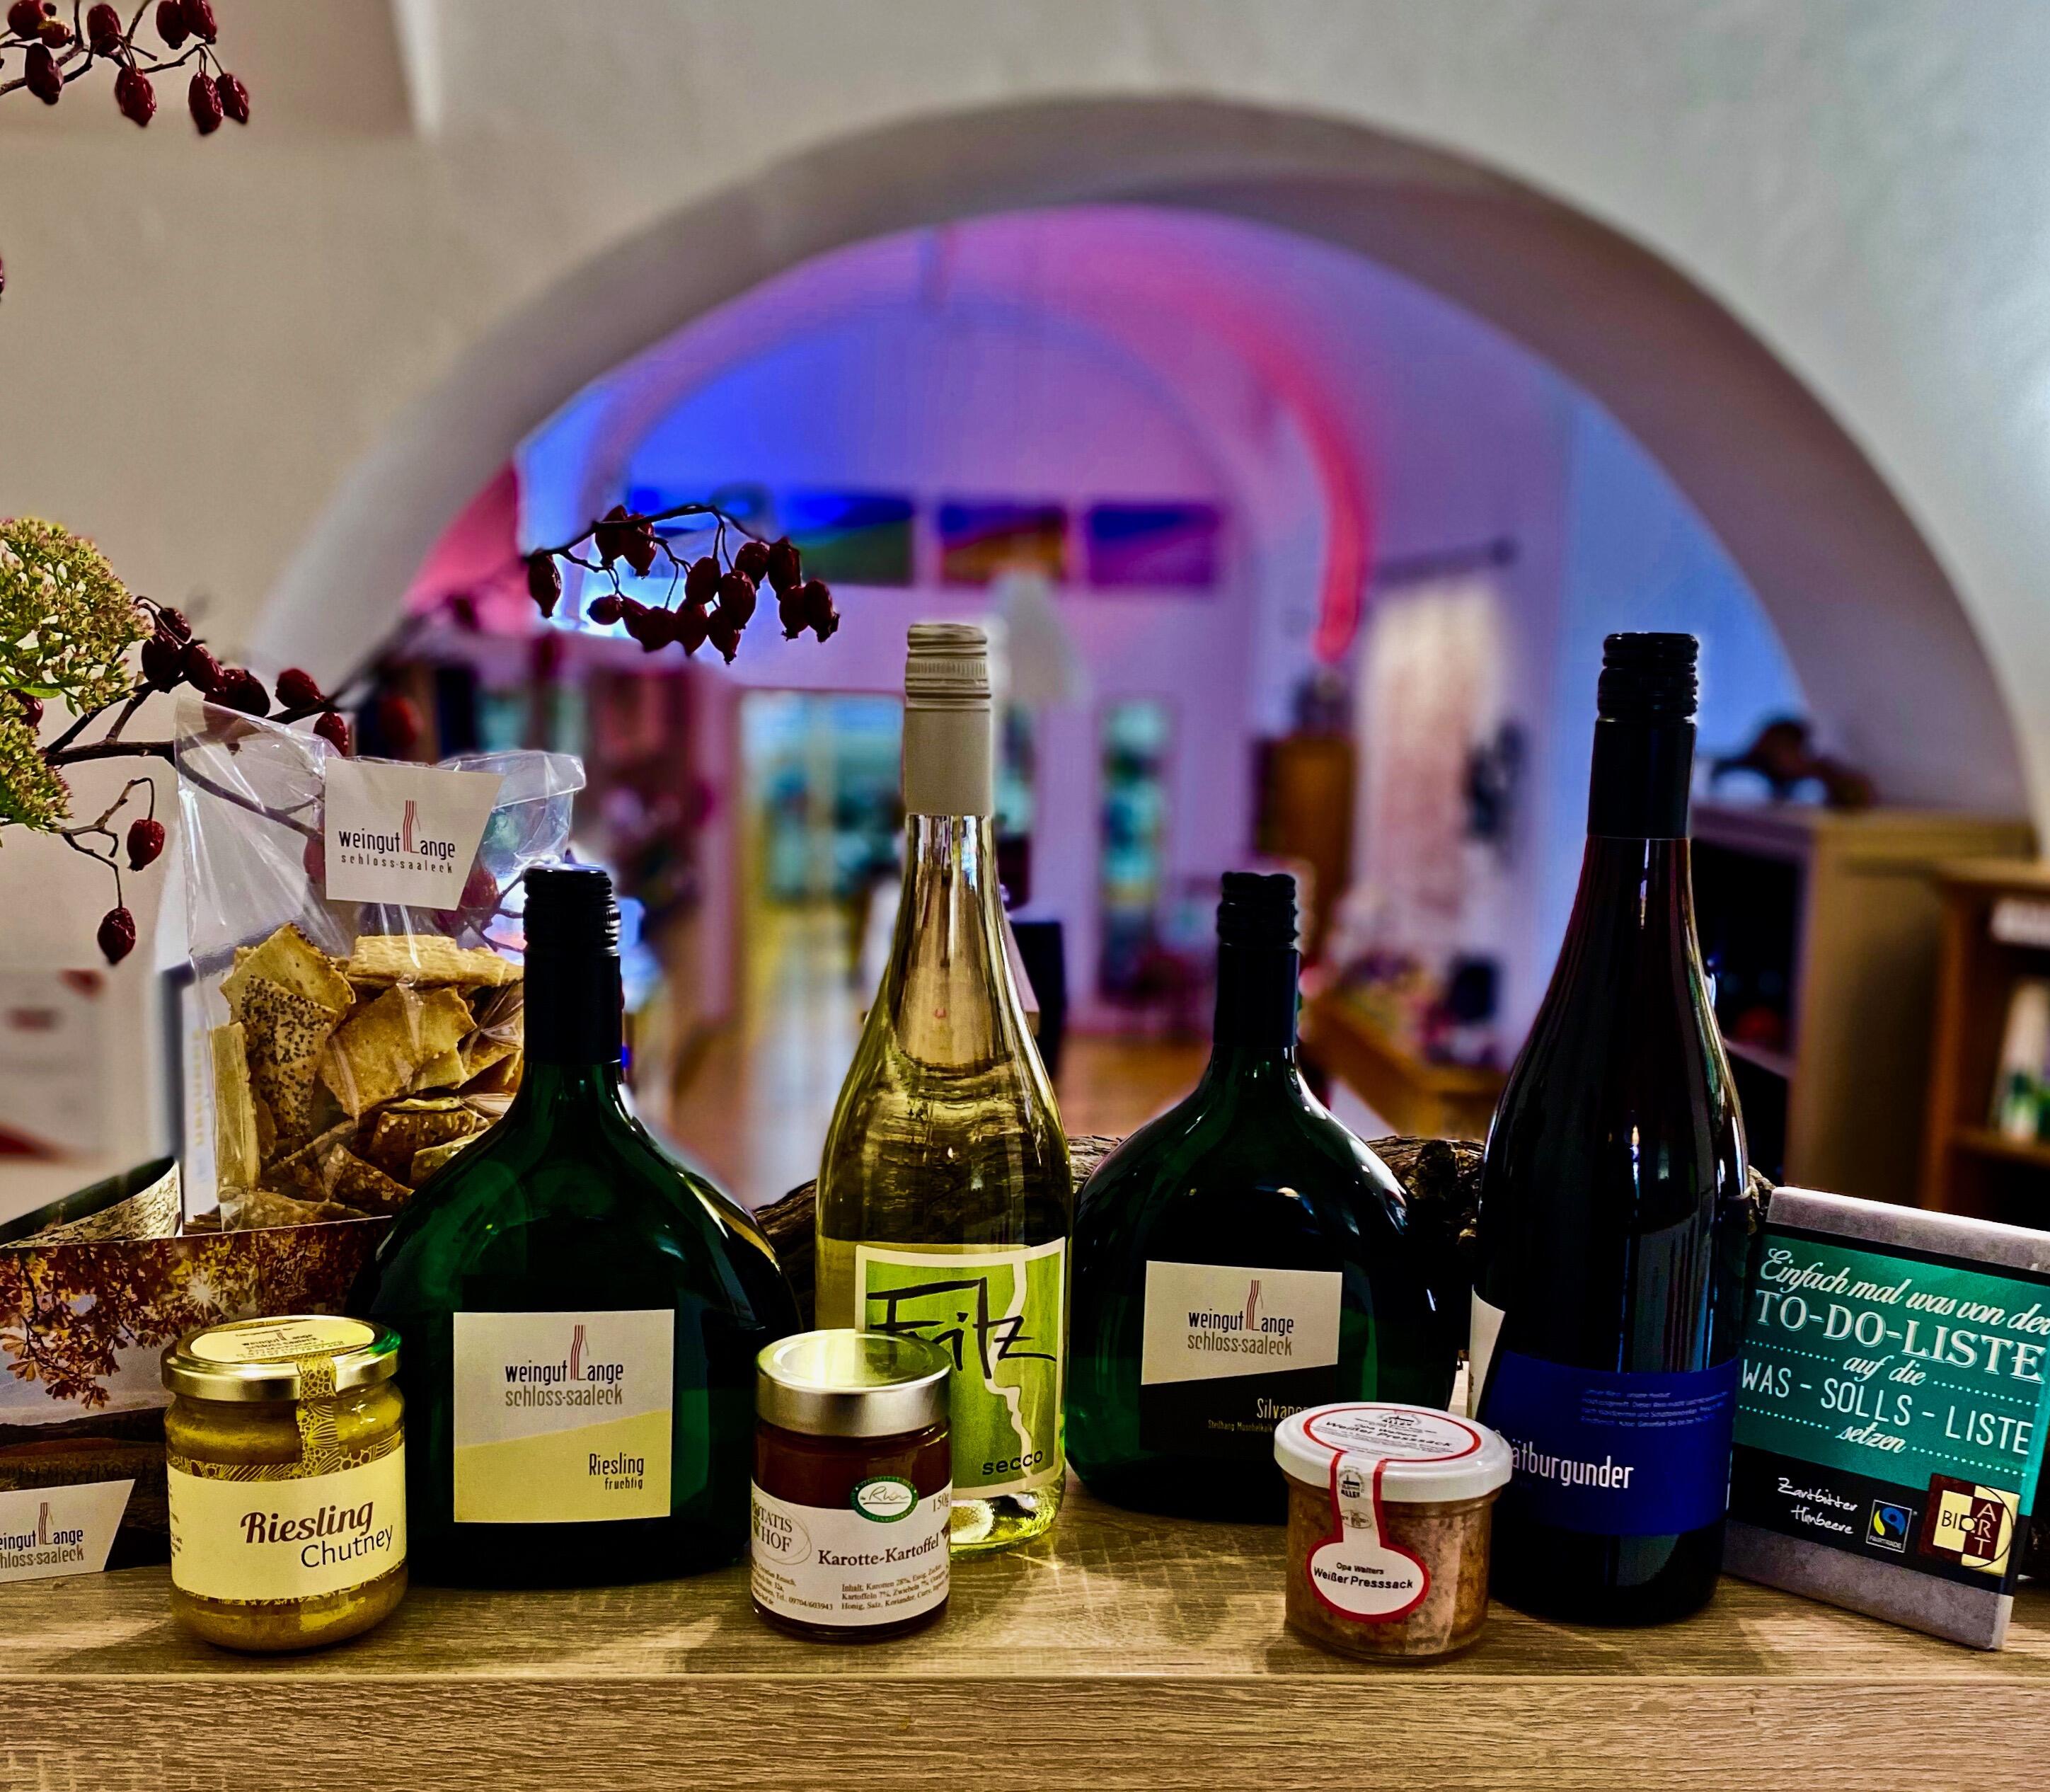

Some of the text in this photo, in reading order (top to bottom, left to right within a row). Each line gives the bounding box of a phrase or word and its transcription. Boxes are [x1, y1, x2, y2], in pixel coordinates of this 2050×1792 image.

[338, 827, 401, 854] weingut
[1759, 1248, 1850, 1295] Einfach
[1847, 1279, 1912, 1305] mal
[1906, 1292, 1960, 1316] was
[1955, 1300, 2008, 1326] von
[1188, 1308, 1244, 1333] weingut
[1755, 1289, 2047, 1384] TO-DO-LISTE
[505, 1360, 568, 1386] weingut
[1842, 1355, 1928, 1386] auf die
[1257, 1398, 1310, 1419] Silvan
[1741, 1359, 1792, 1398] WAS
[1820, 1377, 1913, 1427] SOLLS
[1945, 1405, 2034, 1456] LISTE
[1835, 1422, 1907, 1454] setzen
[589, 1452, 645, 1476] Riesling
[982, 1450, 1043, 1476] secco
[1511, 1437, 1635, 1489] ätburgunder
[604, 1476, 643, 1491] fruchtig
[240, 1501, 374, 1544] Riesling
[0, 1529, 36, 1552] eingut
[301, 1525, 393, 1568] Chutney
[761, 1525, 792, 1552] HOF
[818, 1532, 940, 1566] Karotte-Kartoffel
[1314, 1566, 1414, 1589] Weißer Presssack
[1336, 1562, 1384, 1575] Opa Walters
